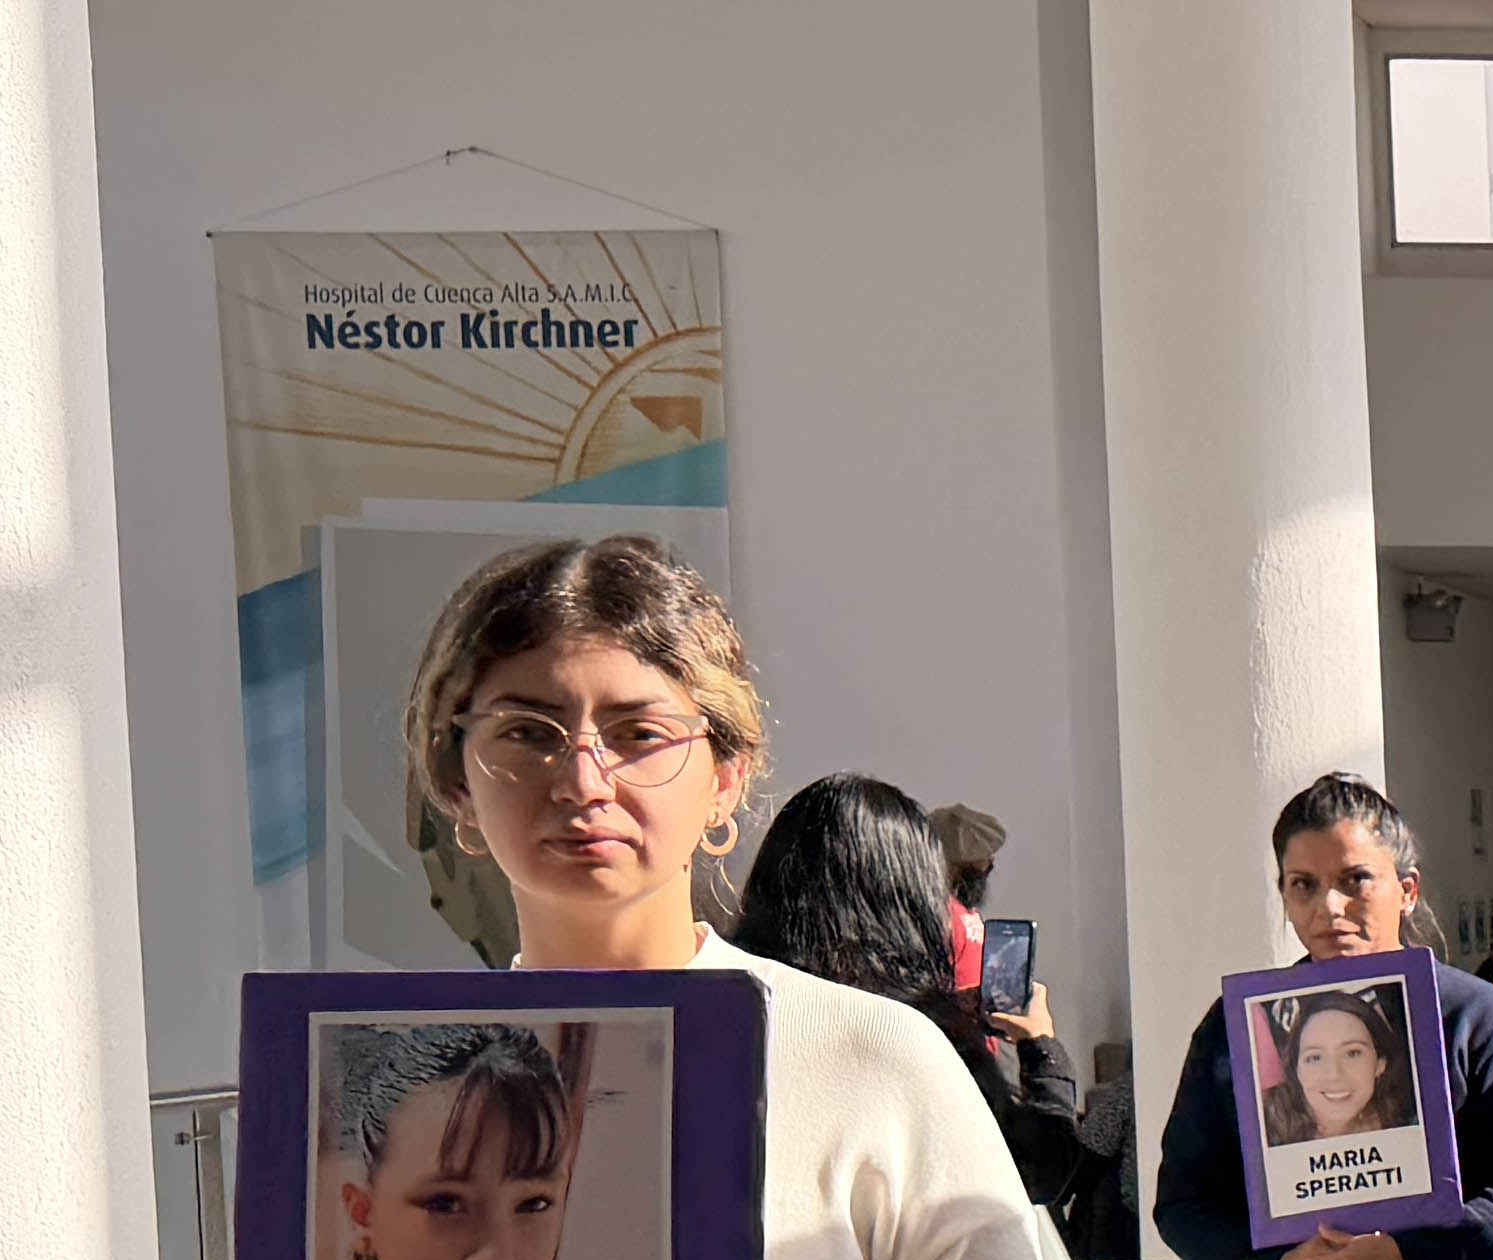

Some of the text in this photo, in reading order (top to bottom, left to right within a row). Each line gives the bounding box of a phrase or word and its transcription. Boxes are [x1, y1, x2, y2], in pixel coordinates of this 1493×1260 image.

[305, 281, 384, 308] Hospital
[392, 282, 416, 304] de
[423, 285, 494, 304] Cuenca
[501, 282, 540, 304] Alta
[306, 308, 639, 349] Néstor Kirchner
[1308, 1146, 1383, 1173] MARIA
[1296, 1166, 1402, 1200] SPERATTI
